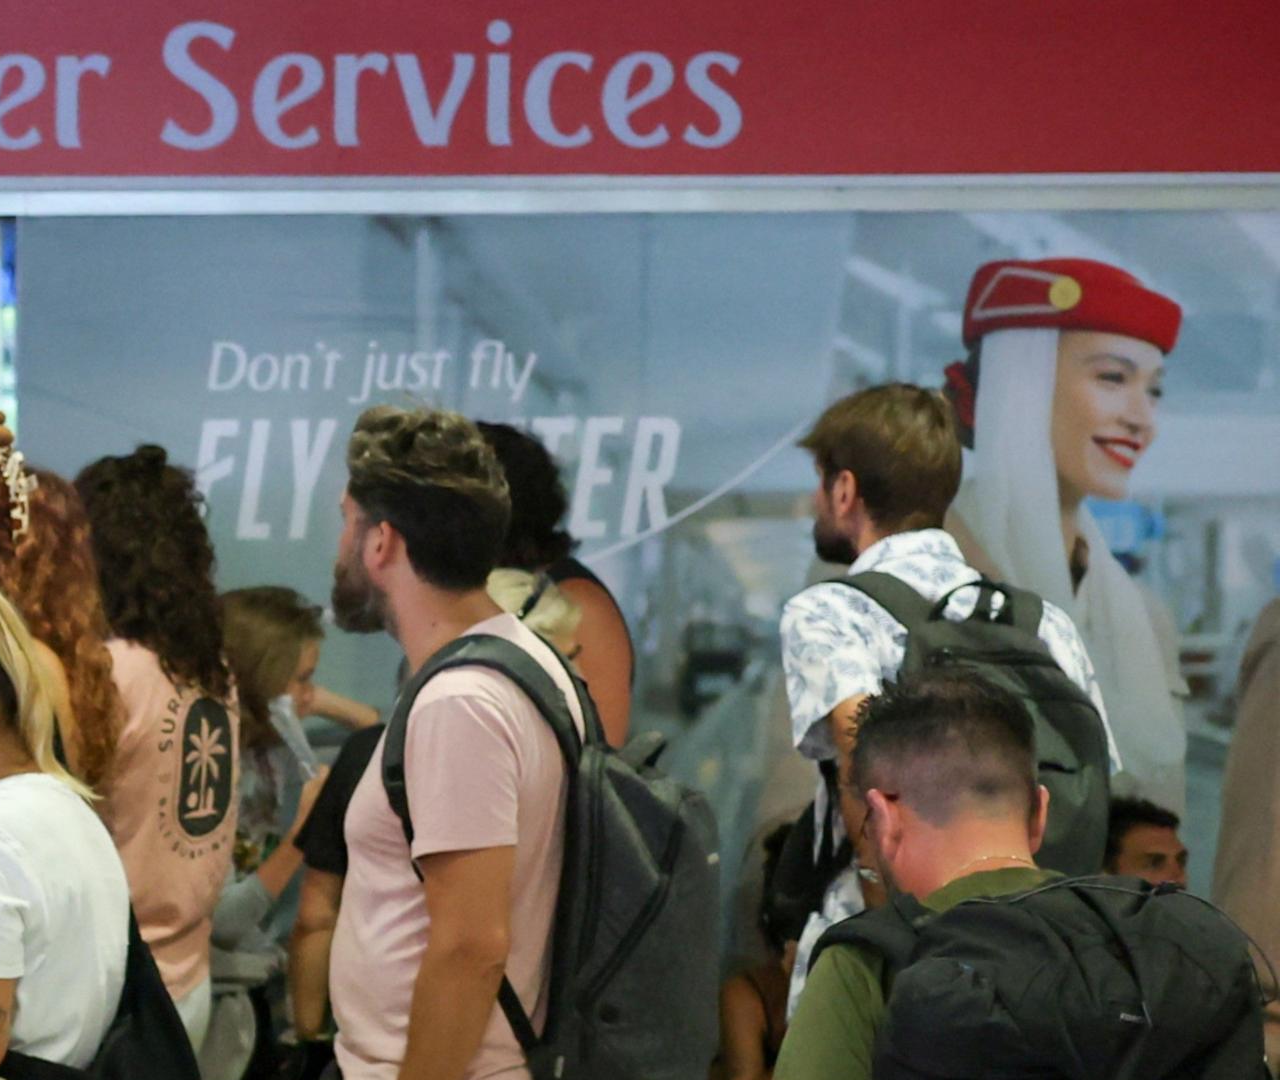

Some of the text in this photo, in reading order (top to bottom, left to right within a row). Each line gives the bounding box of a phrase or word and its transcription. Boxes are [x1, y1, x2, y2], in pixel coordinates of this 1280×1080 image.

[159, 19, 742, 151] Services
[207, 338, 537, 404] Don't just fly
[196, 417, 337, 540] FLY
